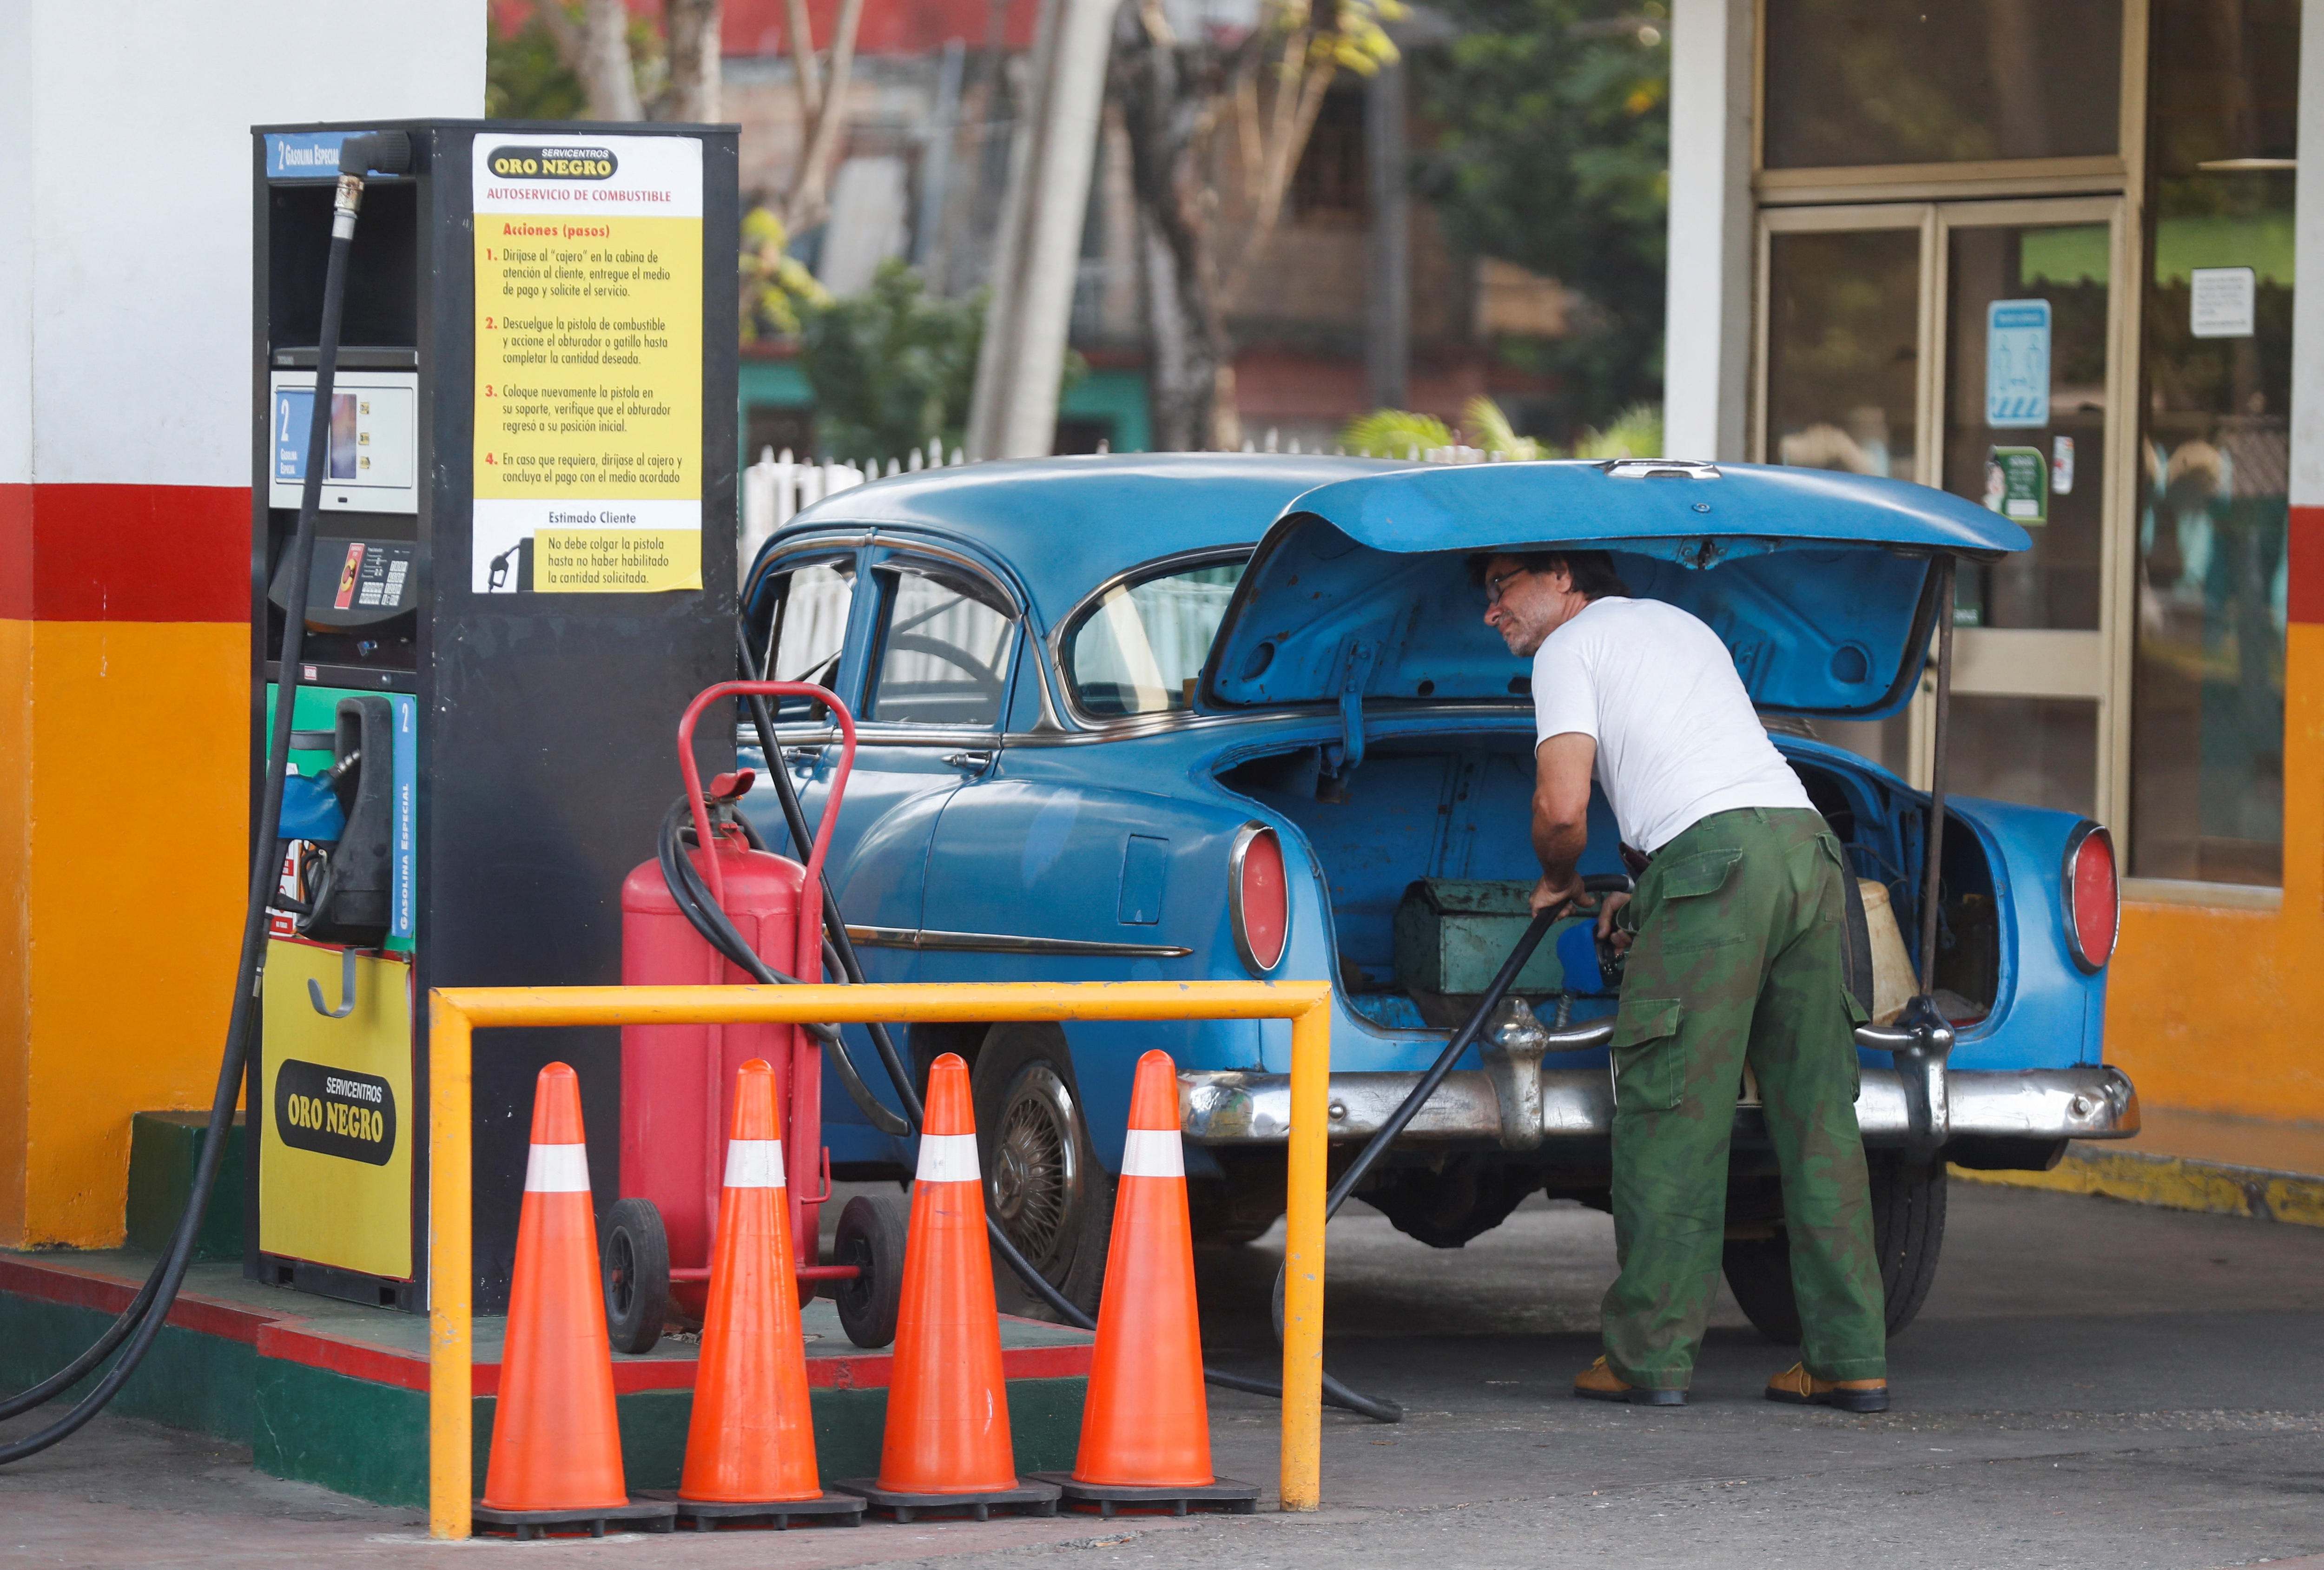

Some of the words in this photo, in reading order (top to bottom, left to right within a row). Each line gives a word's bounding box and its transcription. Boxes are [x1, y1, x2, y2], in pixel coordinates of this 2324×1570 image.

[278, 140, 284, 171] 2
[541, 148, 610, 158] SERVICENTROS
[494, 158, 538, 175] ORO
[541, 159, 612, 176] NEGRO
[487, 188, 570, 200] AUTOSERVICIO
[574, 189, 588, 201] DE
[592, 190, 671, 202] COMBUSTIBLE
[502, 222, 558, 236] Acciones
[562, 224, 610, 240] (pasos)
[486, 248, 498, 261] 1.
[539, 247, 548, 262] al
[590, 253, 601, 262] en
[604, 248, 613, 263] la
[615, 249, 644, 263] cabina
[647, 249, 658, 263] de
[502, 266, 541, 279] atención
[543, 264, 552, 278] al
[555, 265, 586, 281] cliente,
[589, 266, 629, 284] entregue
[632, 265, 640, 280] el
[643, 266, 670, 280] medio
[502, 281, 514, 295] de
[516, 286, 539, 299] pago
[541, 286, 548, 299] y
[550, 282, 581, 297] solicite
[583, 282, 591, 297] el
[594, 284, 630, 297] servicio.
[485, 317, 498, 330] 2.
[503, 316, 554, 333] Descuelgue
[556, 316, 564, 330] la
[567, 316, 596, 333] pistola
[599, 316, 610, 330] de
[613, 317, 666, 331] combustible
[502, 337, 508, 349] y
[511, 334, 544, 347] accione
[547, 332, 555, 347] el
[558, 333, 602, 347] obturador
[605, 338, 611, 348] o
[613, 333, 641, 351] gatillo
[644, 334, 668, 348] hasta
[502, 349, 547, 366] completar
[550, 350, 558, 364] la
[561, 350, 599, 364] cantidad
[601, 350, 641, 365] deseada.
[485, 384, 498, 397] 3.
[502, 383, 538, 400] Coloque
[541, 387, 597, 398] nuevamente
[600, 384, 607, 398] la
[610, 384, 640, 401] pistola
[642, 389, 653, 398] en
[502, 405, 513, 415] su
[515, 403, 551, 417] soporte,
[554, 400, 594, 418] verifique
[597, 406, 614, 418] que
[616, 401, 624, 415] el
[627, 401, 671, 416] obturador
[281, 398, 289, 442] 2
[502, 419, 536, 435] regresó
[539, 422, 545, 431] a
[548, 422, 557, 432] su
[560, 419, 596, 435] posición
[599, 418, 627, 432] inicial.
[485, 452, 498, 465] 4.
[503, 452, 514, 465] En
[516, 456, 536, 465] caso
[538, 456, 555, 468] que
[558, 453, 598, 468] requiera,
[636, 452, 645, 466] al
[647, 454, 674, 469] cajero
[677, 457, 682, 469] y
[502, 468, 541, 485] concluya
[544, 468, 552, 482] el
[555, 473, 577, 486] pago
[580, 473, 595, 483] con
[598, 468, 606, 482] el
[609, 468, 636, 483] medio
[639, 469, 680, 483] acordado
[549, 511, 596, 523] Estimado
[600, 511, 636, 524] Cliente
[548, 537, 561, 550] No
[564, 536, 587, 550] debe
[590, 536, 619, 553] colgar
[621, 536, 630, 550] la
[633, 536, 664, 553] pistola
[548, 553, 573, 567] hasta
[576, 557, 588, 567] no
[591, 553, 619, 567] haber
[621, 553, 669, 567] habilitado
[548, 570, 557, 583] la
[560, 570, 600, 584] cantidad
[602, 570, 649, 584] solicitada.
[402, 702, 409, 732] 2
[400, 854, 409, 930] GASOLINA
[326, 1076, 382, 1103] SERVICENTROS
[288, 1093, 323, 1130] ORO
[326, 1101, 383, 1143] NEGRO
